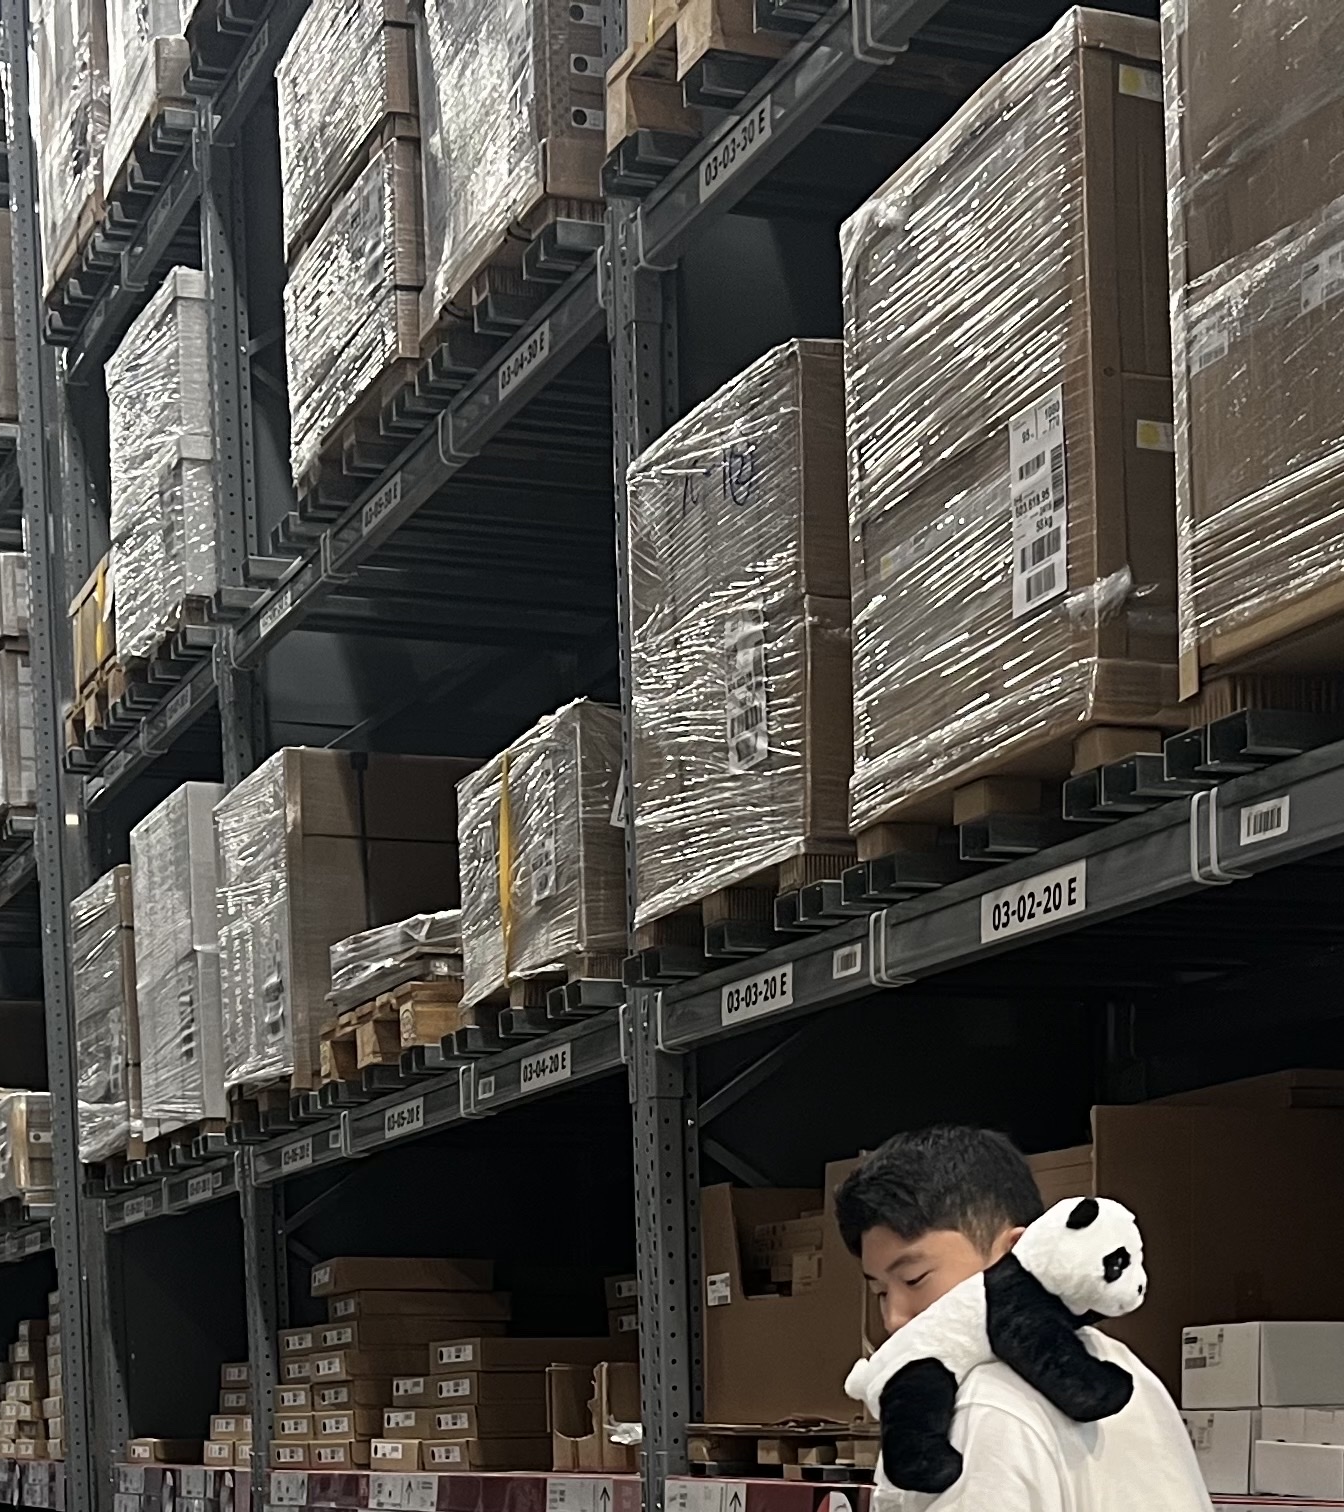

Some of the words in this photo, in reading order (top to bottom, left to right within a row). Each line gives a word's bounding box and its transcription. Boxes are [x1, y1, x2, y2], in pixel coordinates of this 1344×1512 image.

[704, 118, 755, 187] 03-03-30
[758, 108, 766, 135] E
[992, 882, 1062, 932] 03-02-20
[1067, 876, 1077, 907] E
[726, 975, 777, 1014] 03-03-20
[780, 972, 787, 997] E
[522, 1054, 559, 1083] 03-04-20
[561, 1050, 567, 1070] E
